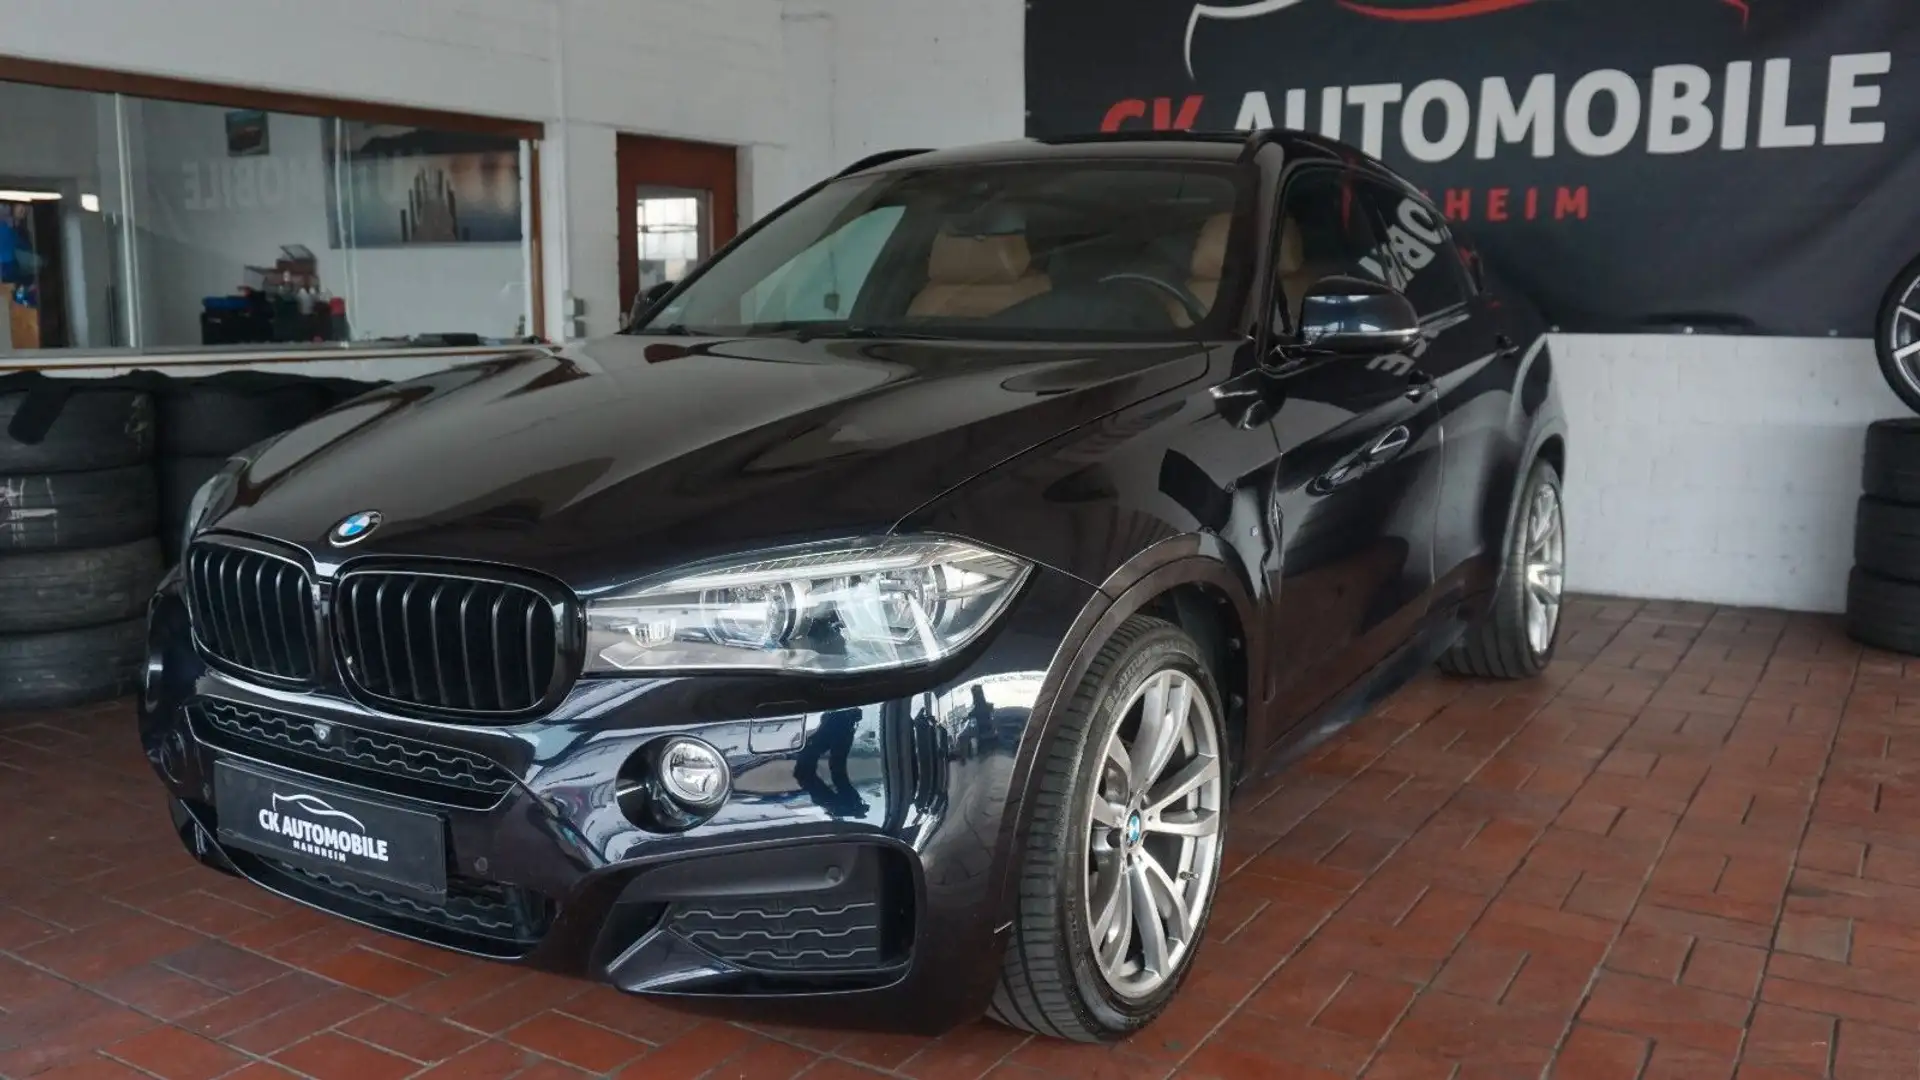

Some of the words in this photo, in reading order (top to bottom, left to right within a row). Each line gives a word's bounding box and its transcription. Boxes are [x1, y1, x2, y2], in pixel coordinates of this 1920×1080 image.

[1423, 186, 1588, 221] HEIM
[258, 808, 281, 833] CK
[282, 815, 389, 862] AUTOMOBILE
[293, 840, 346, 862] MANNHEIM
